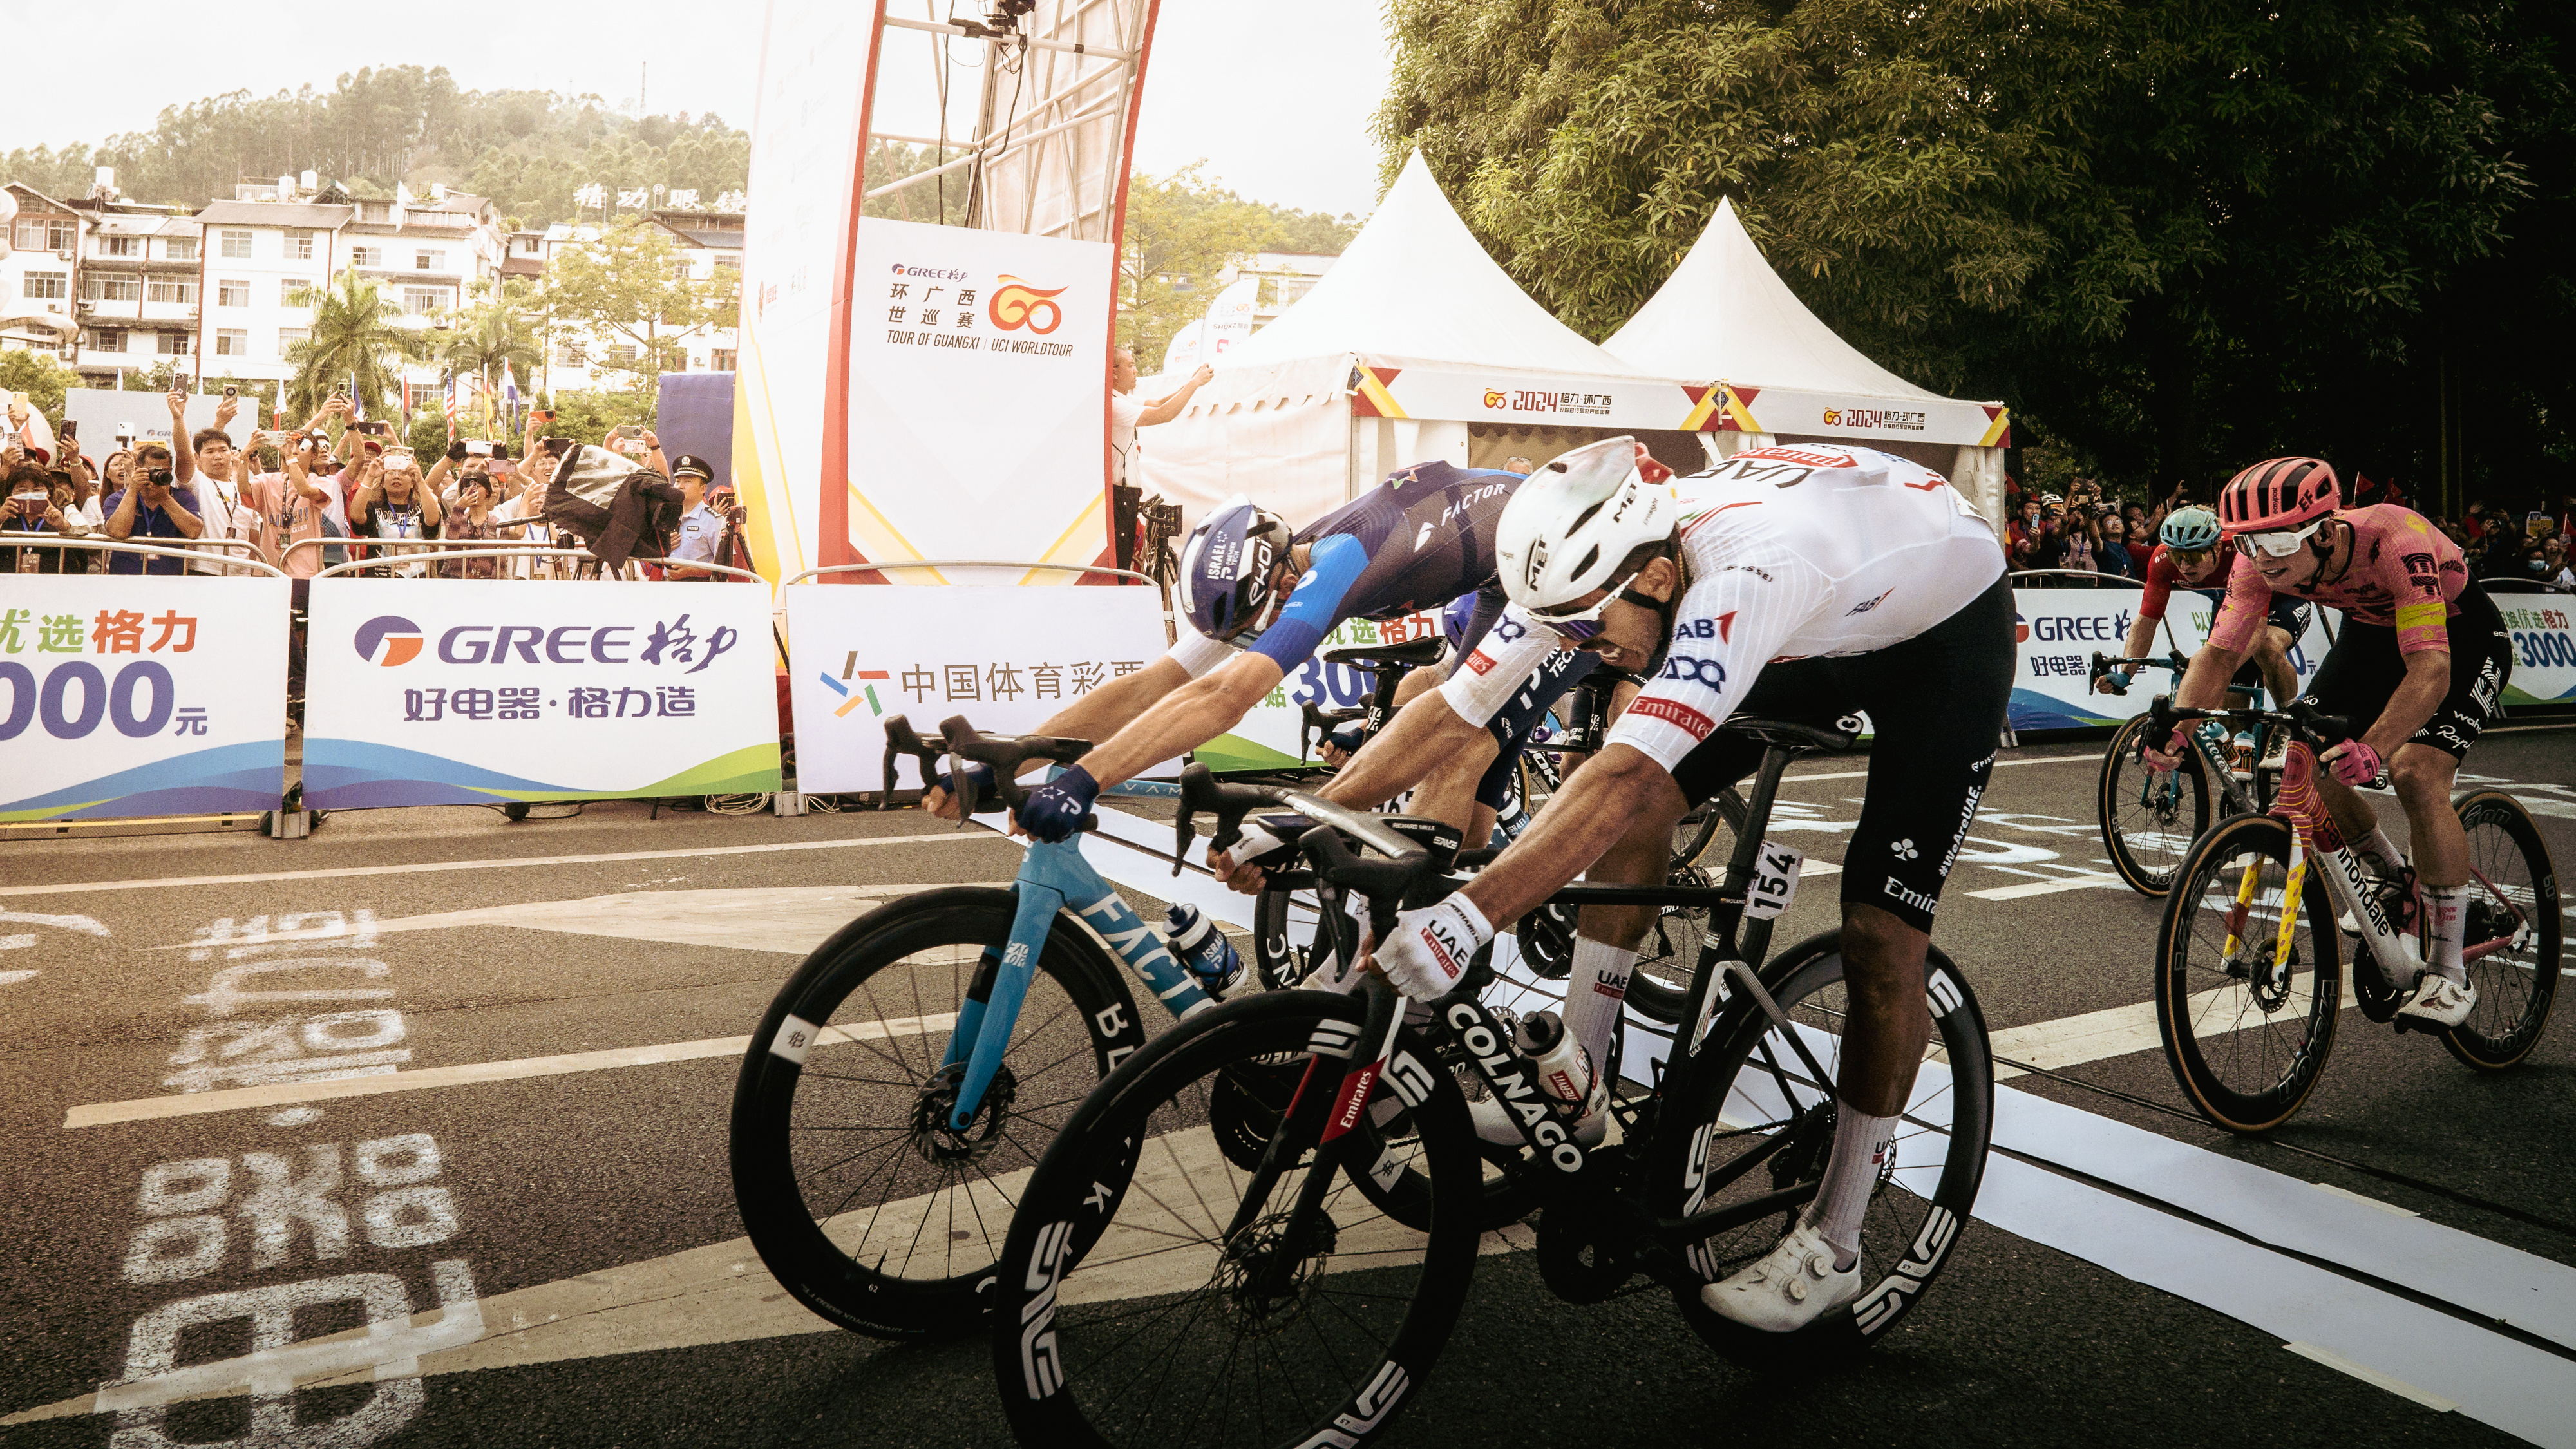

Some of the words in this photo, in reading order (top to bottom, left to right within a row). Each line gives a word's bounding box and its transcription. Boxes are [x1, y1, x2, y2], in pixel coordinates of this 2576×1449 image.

[907, 267, 947, 279] GREE
[887, 330, 913, 345] TOUR
[917, 332, 931, 346] OF
[934, 334, 980, 350] GUANGXI
[991, 339, 1011, 352] UCI
[1012, 341, 1074, 357] WORLDTOUR
[1513, 390, 1558, 412] 2024
[1846, 409, 1882, 428] 2024
[1686, 460, 1819, 488] UAE
[1441, 483, 1506, 527] FACTOR
[2298, 489, 2315, 513] EF
[1208, 541, 1226, 580] ISRAEL
[1227, 542, 1237, 565] PREMIER
[1232, 551, 1240, 565] TECH
[2035, 616, 2112, 641] GREE
[439, 626, 635, 665] GREE
[640, 614, 738, 674] 格力
[2514, 632, 2576, 668] 3000
[2454, 710, 2482, 734] waho
[2437, 724, 2472, 749] Raph
[1507, 817, 1526, 837] ISRAEL
[1753, 853, 1797, 912] 154
[2322, 817, 2389, 936] cannondale
[1079, 891, 1218, 1020] FACT
[1428, 919, 1470, 969] UAE
[1598, 969, 1628, 990] UAE
[1340, 1070, 1372, 1129] Emirates
[1446, 1003, 1584, 1173] COLNAGO
[868, 1283, 878, 1293] 62
